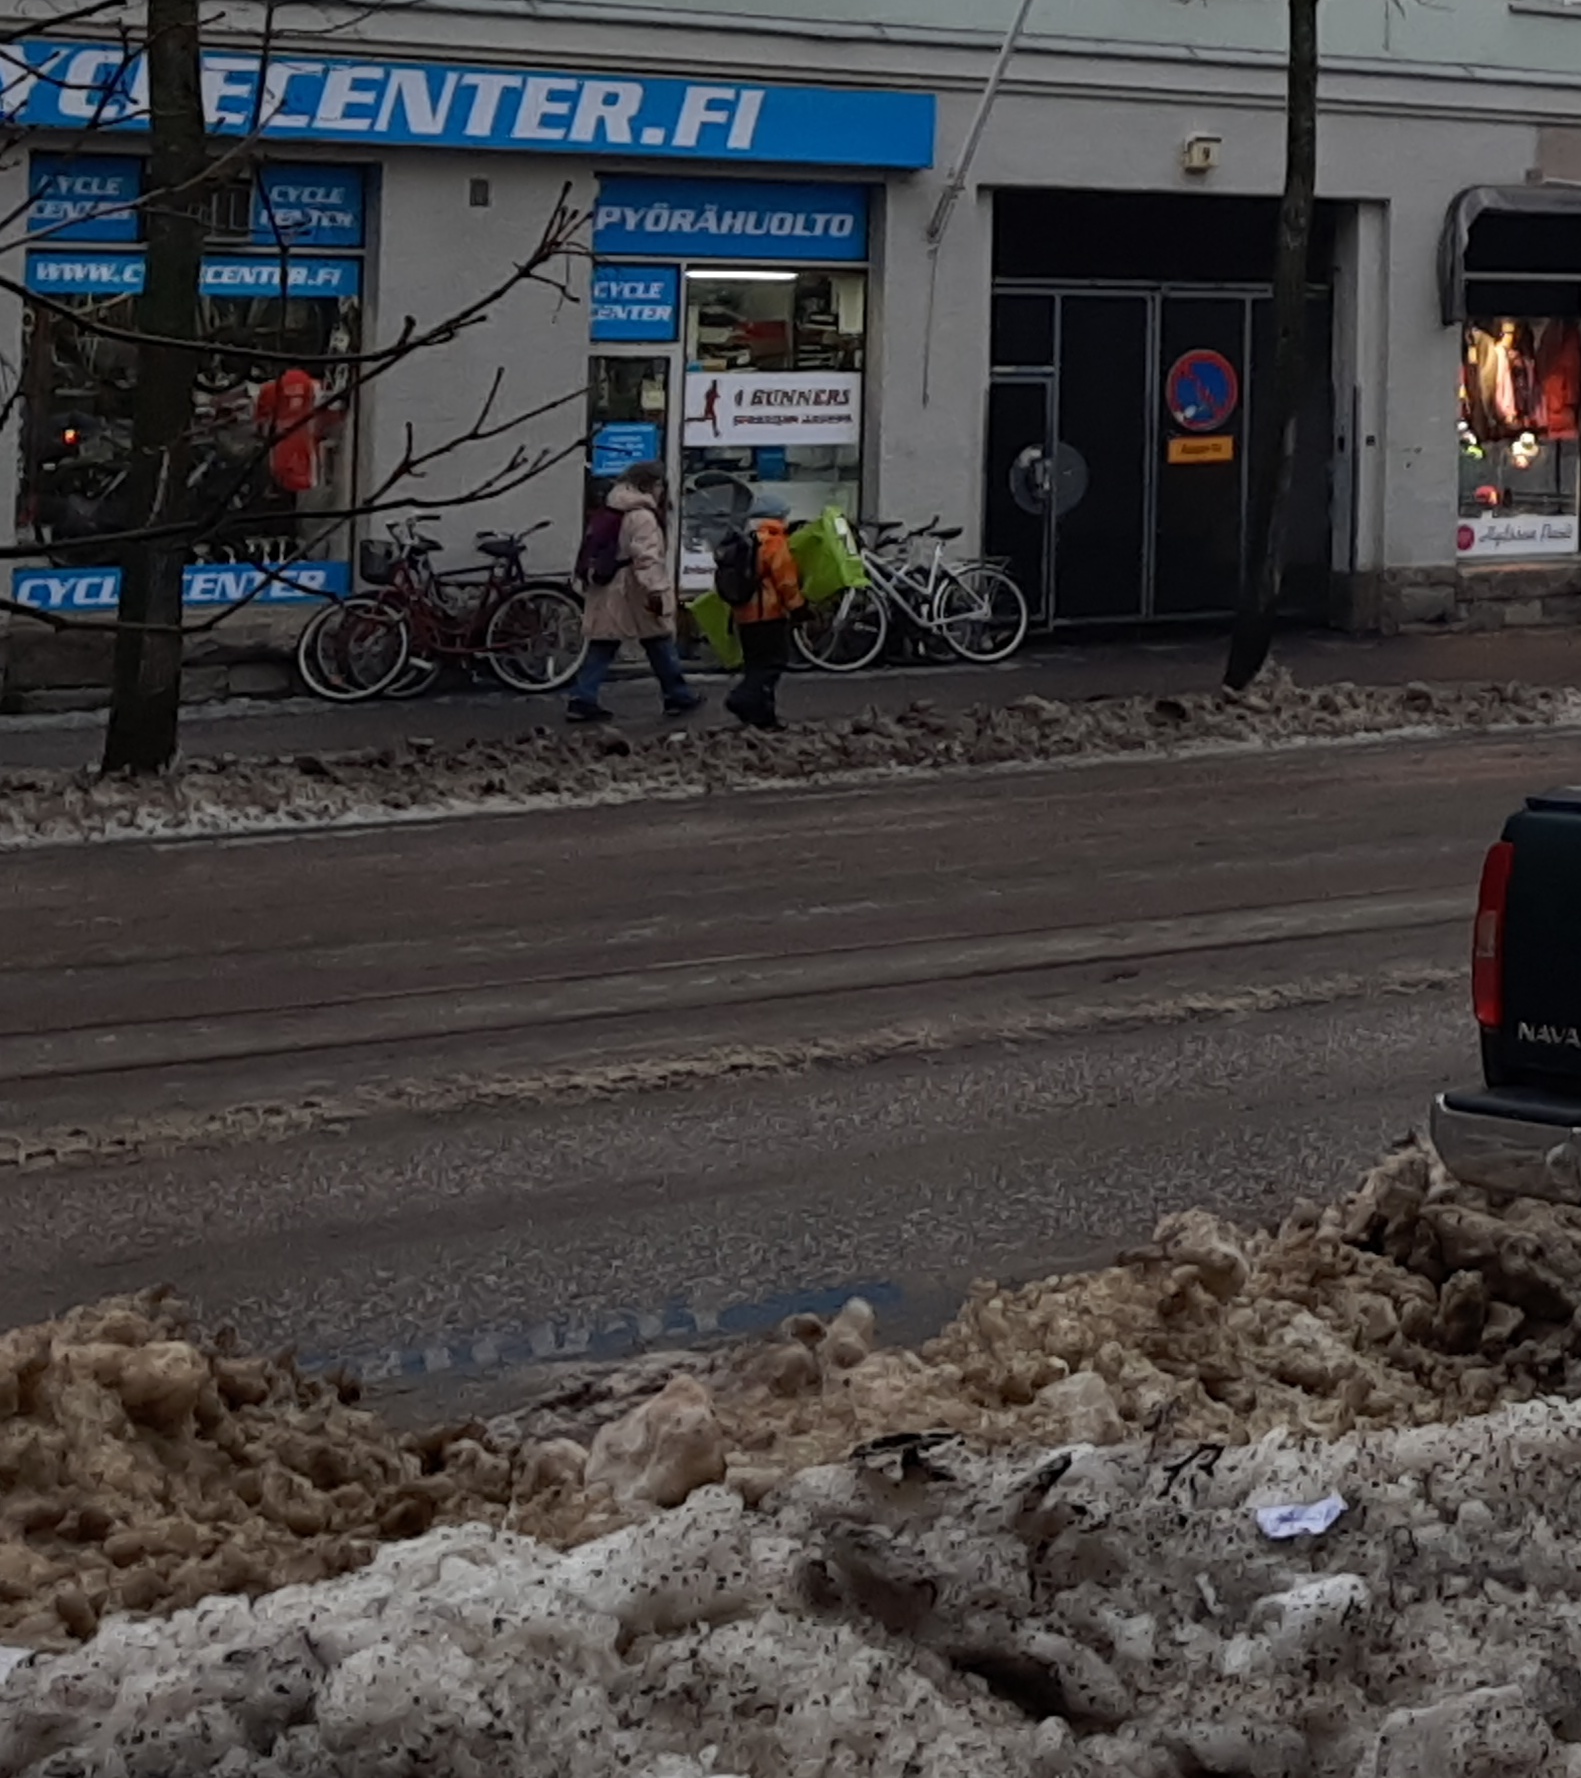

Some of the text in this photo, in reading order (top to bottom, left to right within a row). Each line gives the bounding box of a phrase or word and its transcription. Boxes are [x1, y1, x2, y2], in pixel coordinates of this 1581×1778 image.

[0, 44, 765, 150] YCECENTER.FI
[270, 184, 346, 205] CYCLE
[594, 202, 854, 238] PYÖRÄHUOLTO
[594, 280, 665, 300] CYCLE
[16, 575, 120, 608] CYCL
